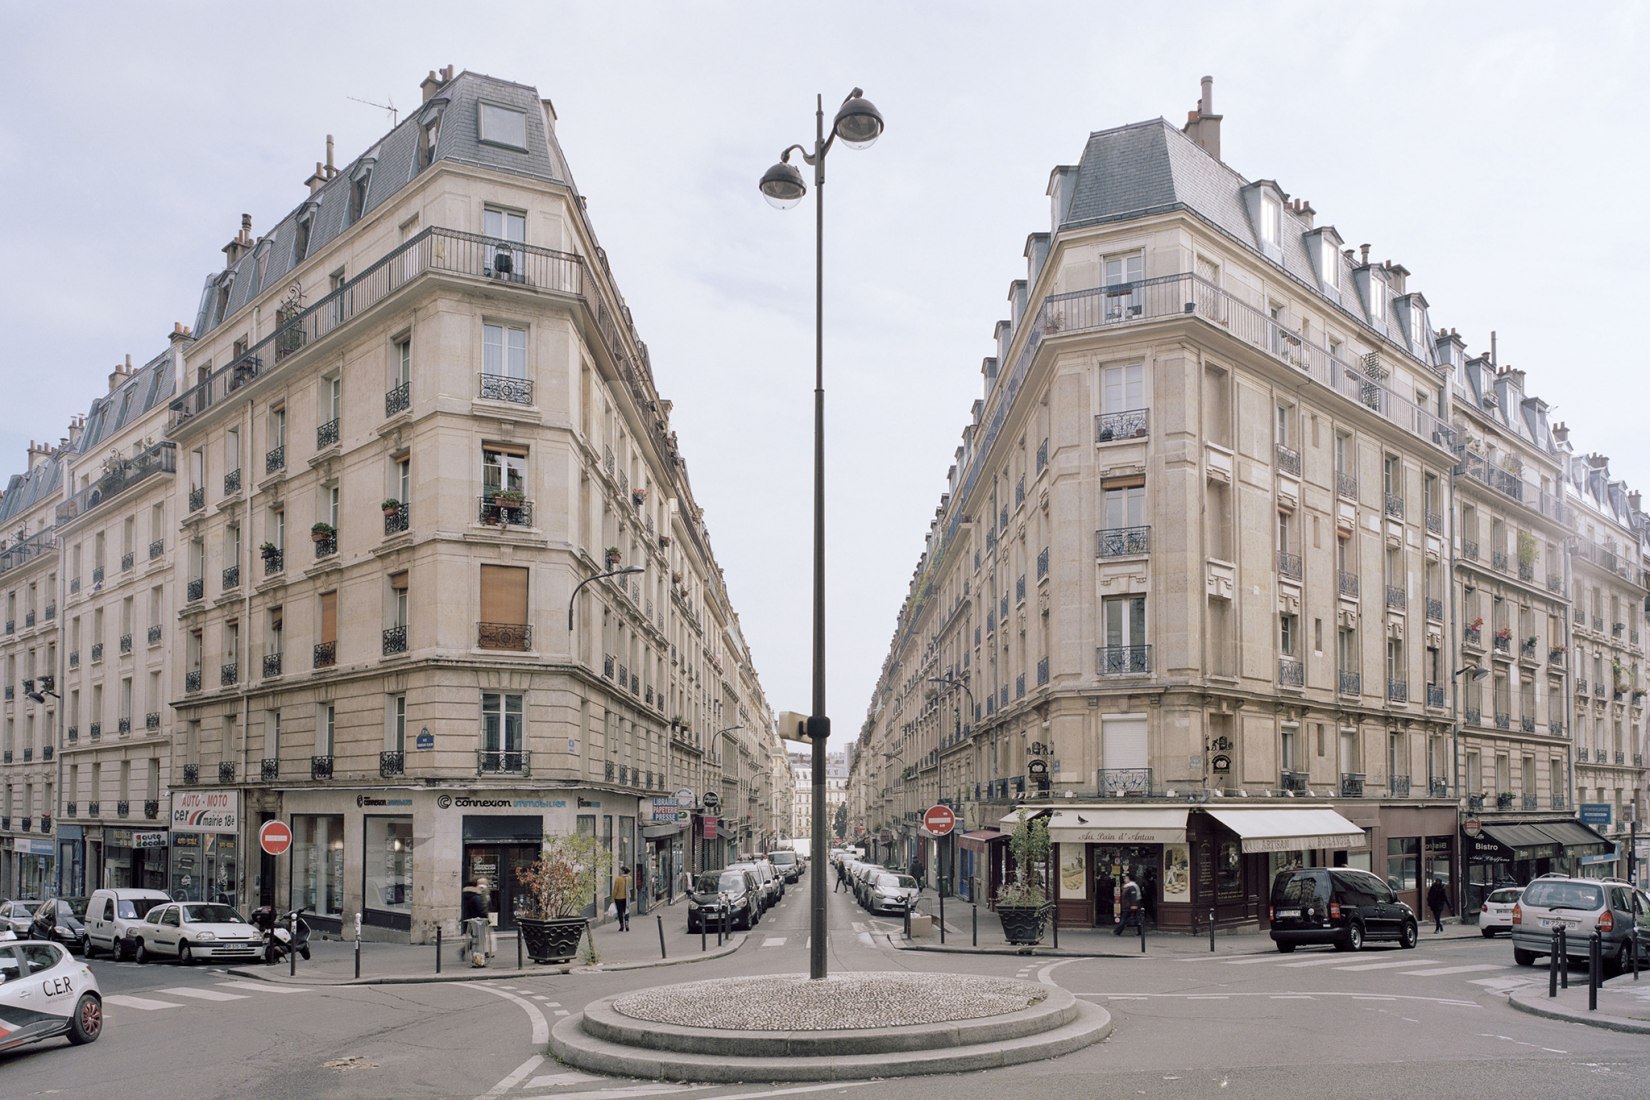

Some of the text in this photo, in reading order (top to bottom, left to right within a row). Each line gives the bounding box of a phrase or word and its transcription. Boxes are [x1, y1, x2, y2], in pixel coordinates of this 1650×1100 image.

[182, 794, 200, 807] AUTO
[206, 794, 228, 807] MOTO
[455, 799, 512, 808] connexion
[654, 798, 678, 806] LIBRAIRIE
[653, 806, 678, 814] PAPETERIE
[174, 810, 190, 821] cer
[203, 814, 222, 826] mairie
[1096, 832, 1115, 840] Pain
[1475, 842, 1498, 850] Bistro
